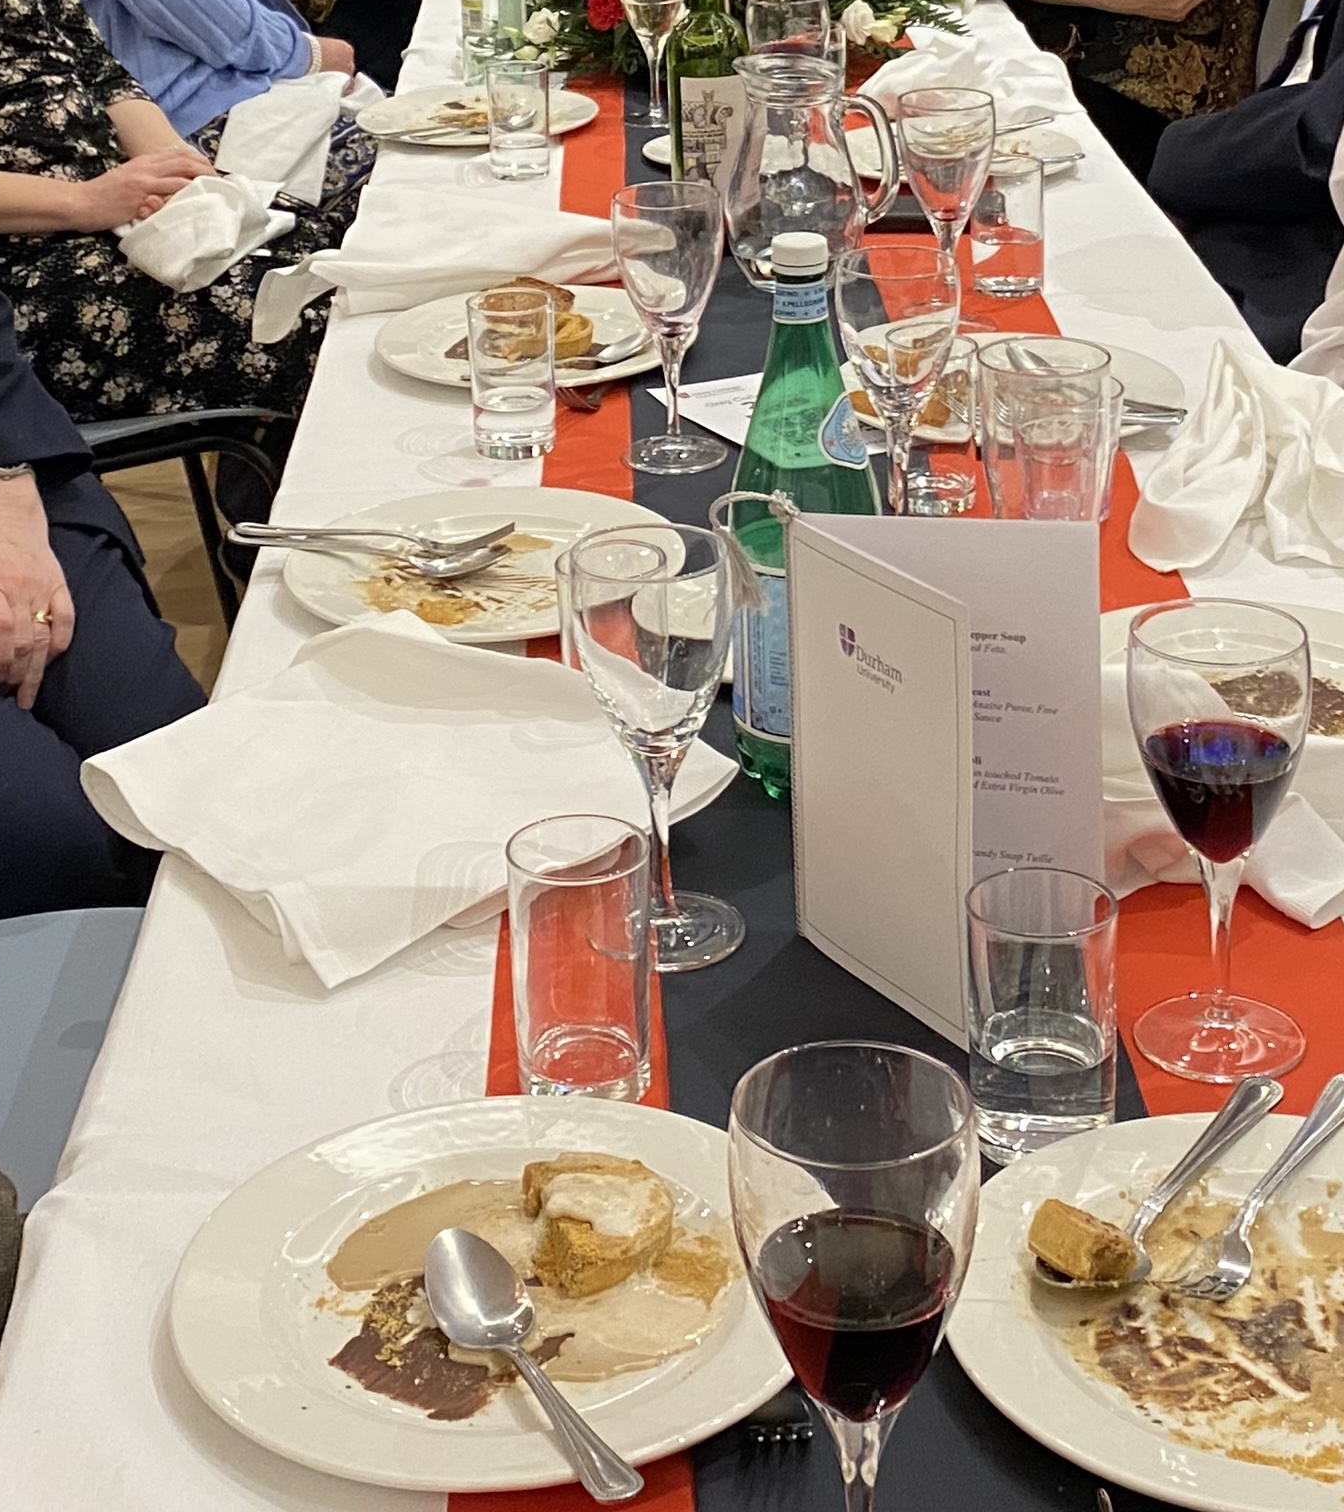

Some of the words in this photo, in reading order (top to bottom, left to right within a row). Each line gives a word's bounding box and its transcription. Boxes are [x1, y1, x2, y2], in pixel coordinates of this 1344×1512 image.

[970, 632, 998, 641] epper
[1000, 632, 1027, 644] Soup
[856, 644, 903, 684] Durham
[1023, 772, 1059, 783] Tomato
[1009, 783, 1038, 795] Virgin
